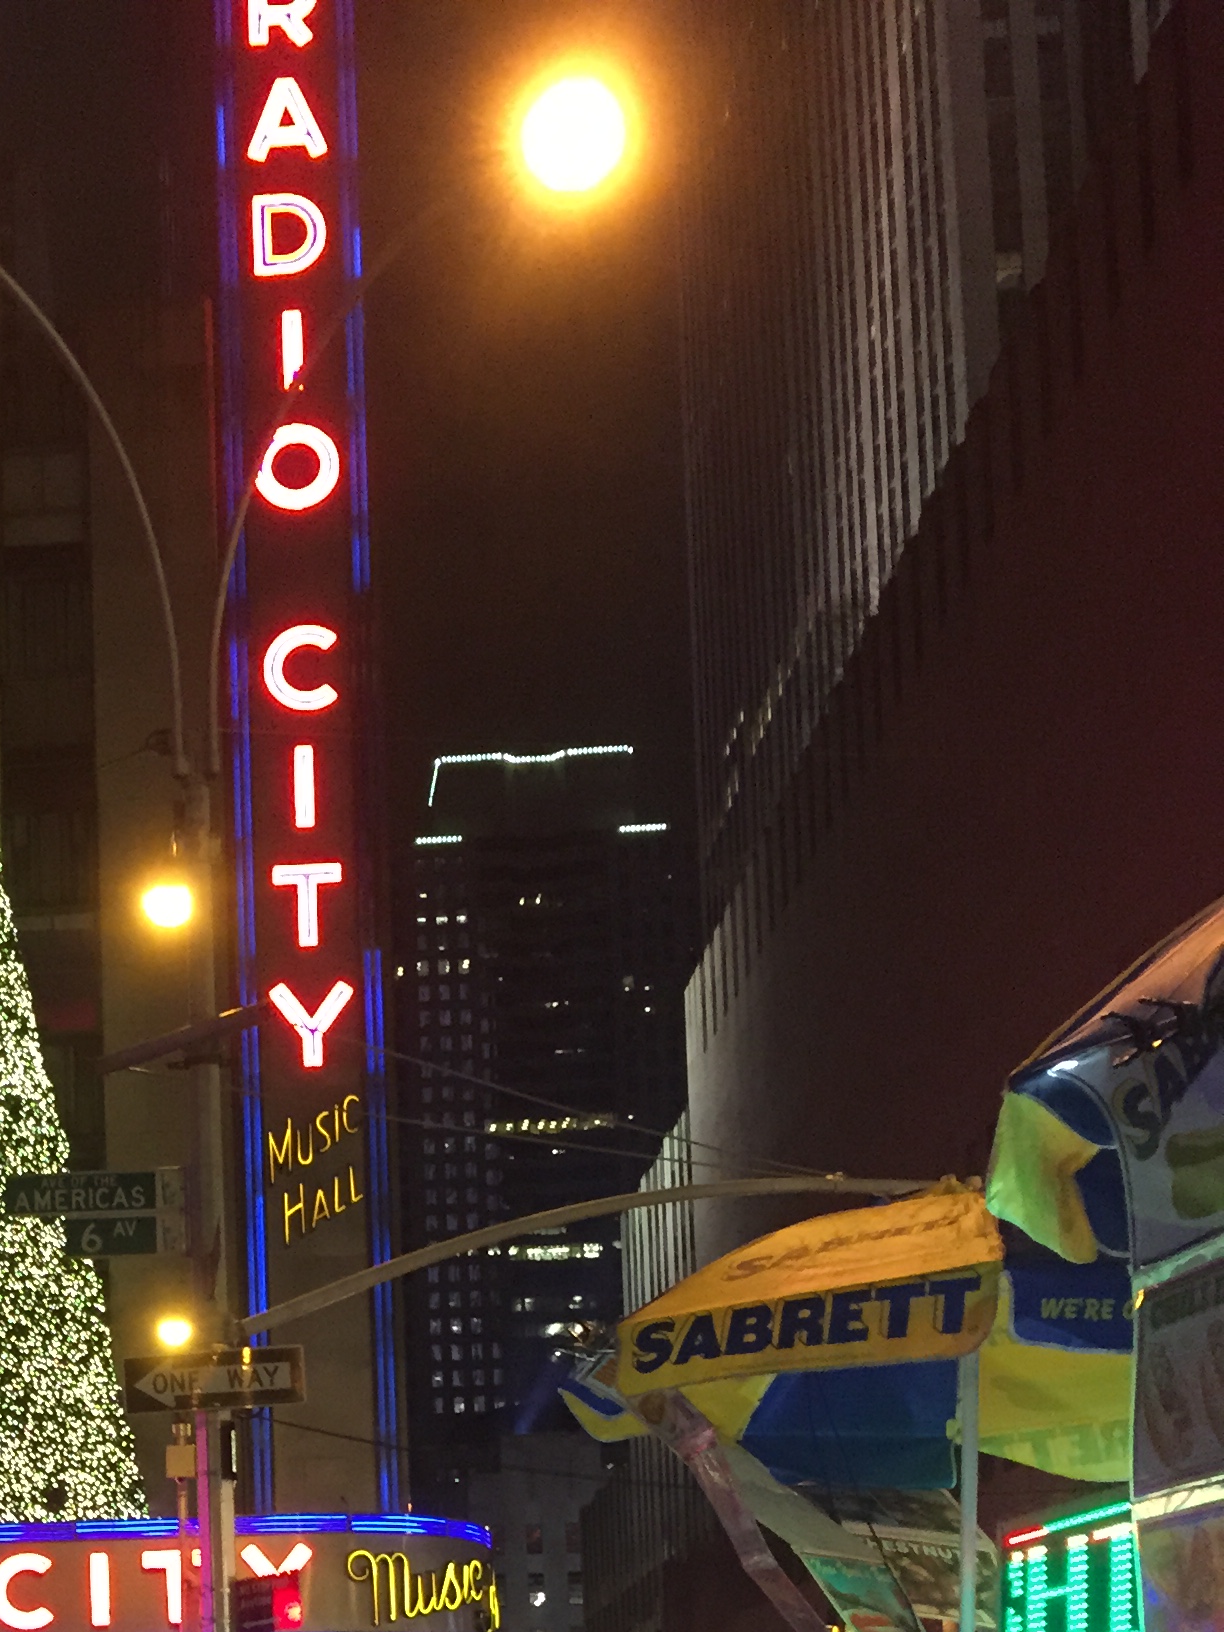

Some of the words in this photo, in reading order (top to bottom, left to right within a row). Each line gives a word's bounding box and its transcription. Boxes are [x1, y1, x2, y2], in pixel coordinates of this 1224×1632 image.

[262, 624, 354, 1068] CITY
[14, 1186, 146, 1213] AMERICAS
[93, 1175, 119, 1186] THE
[281, 1166, 365, 1245] HALL
[81, 1222, 103, 1253] 6
[113, 1220, 138, 1238] AV
[632, 1271, 982, 1374] SABRETT
[151, 1370, 200, 1395] ONE
[226, 1364, 280, 1390] WAY
[347, 1549, 484, 1626] Music
